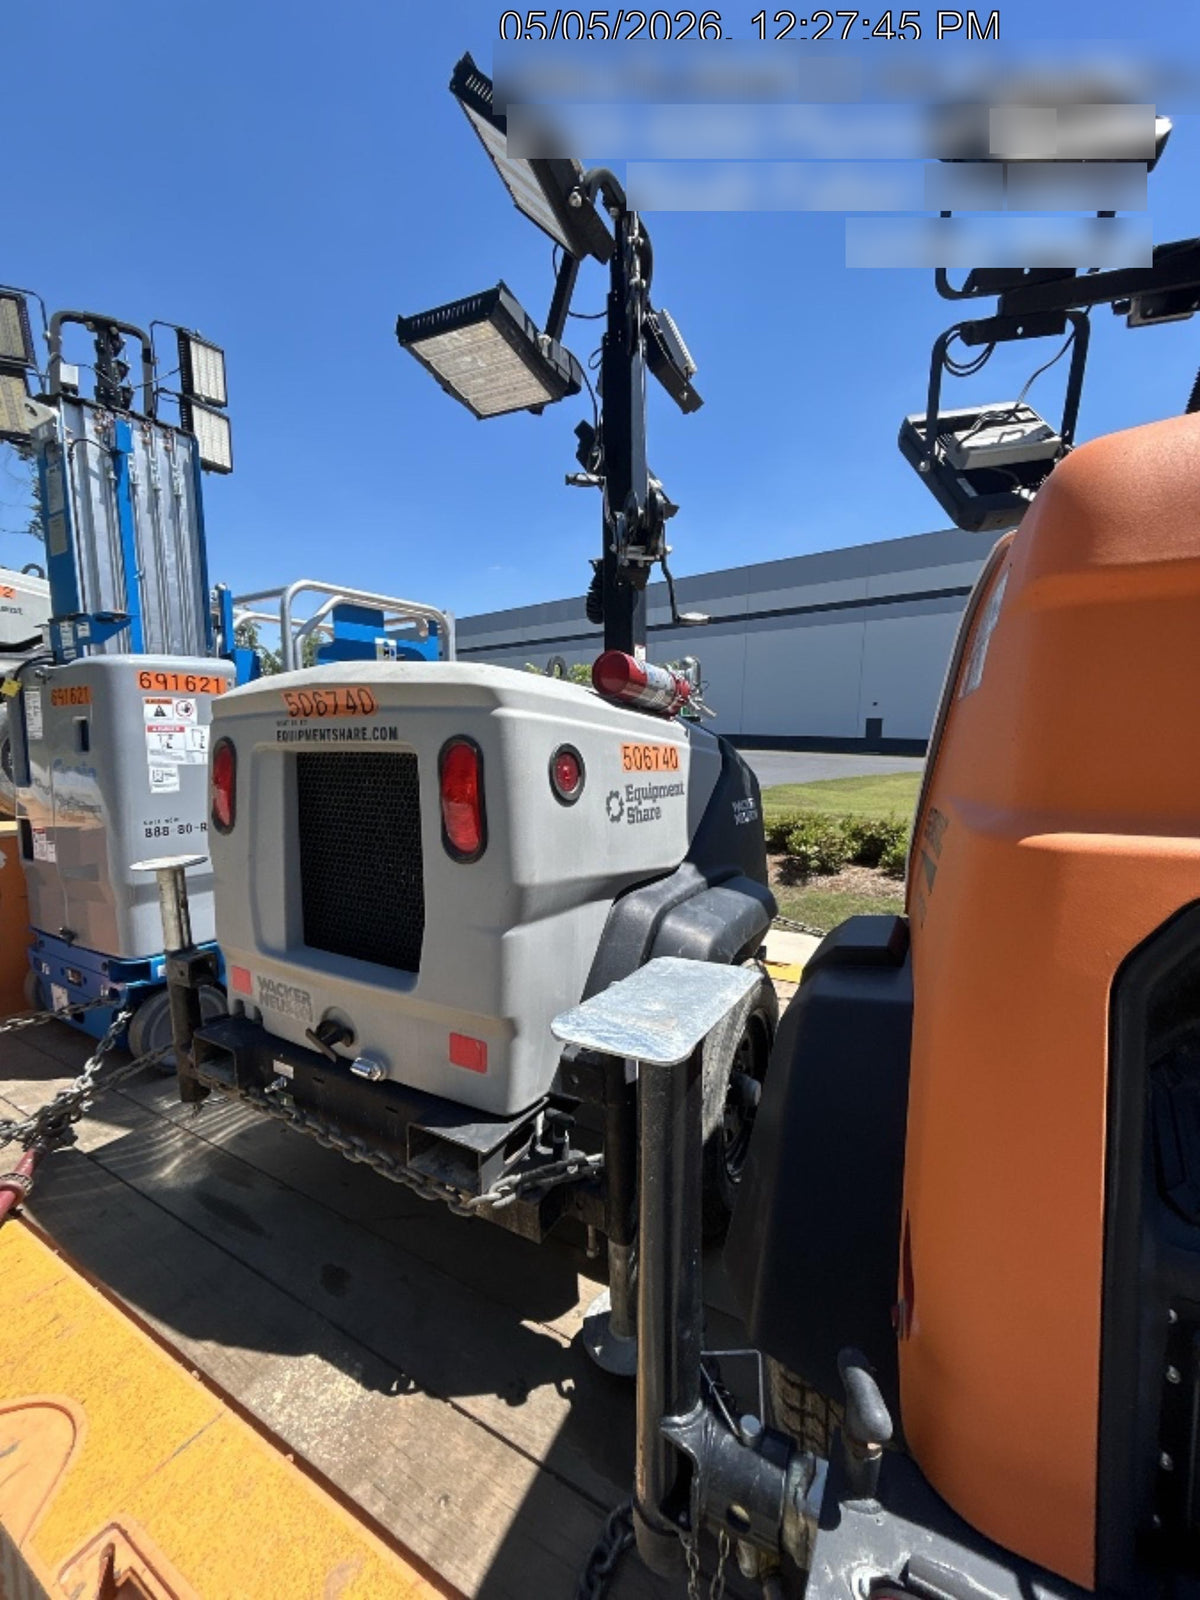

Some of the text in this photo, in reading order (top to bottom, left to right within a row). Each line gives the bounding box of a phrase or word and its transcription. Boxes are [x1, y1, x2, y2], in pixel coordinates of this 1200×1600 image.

[139, 671, 221, 695] 691621
[284, 688, 375, 717] 506740
[276, 726, 398, 742] EQUIPMENTSHARE.COM
[623, 745, 679, 771] 506740
[625, 780, 685, 806] Equipment
[627, 805, 662, 824] Share
[257, 975, 312, 1006] WACKER
